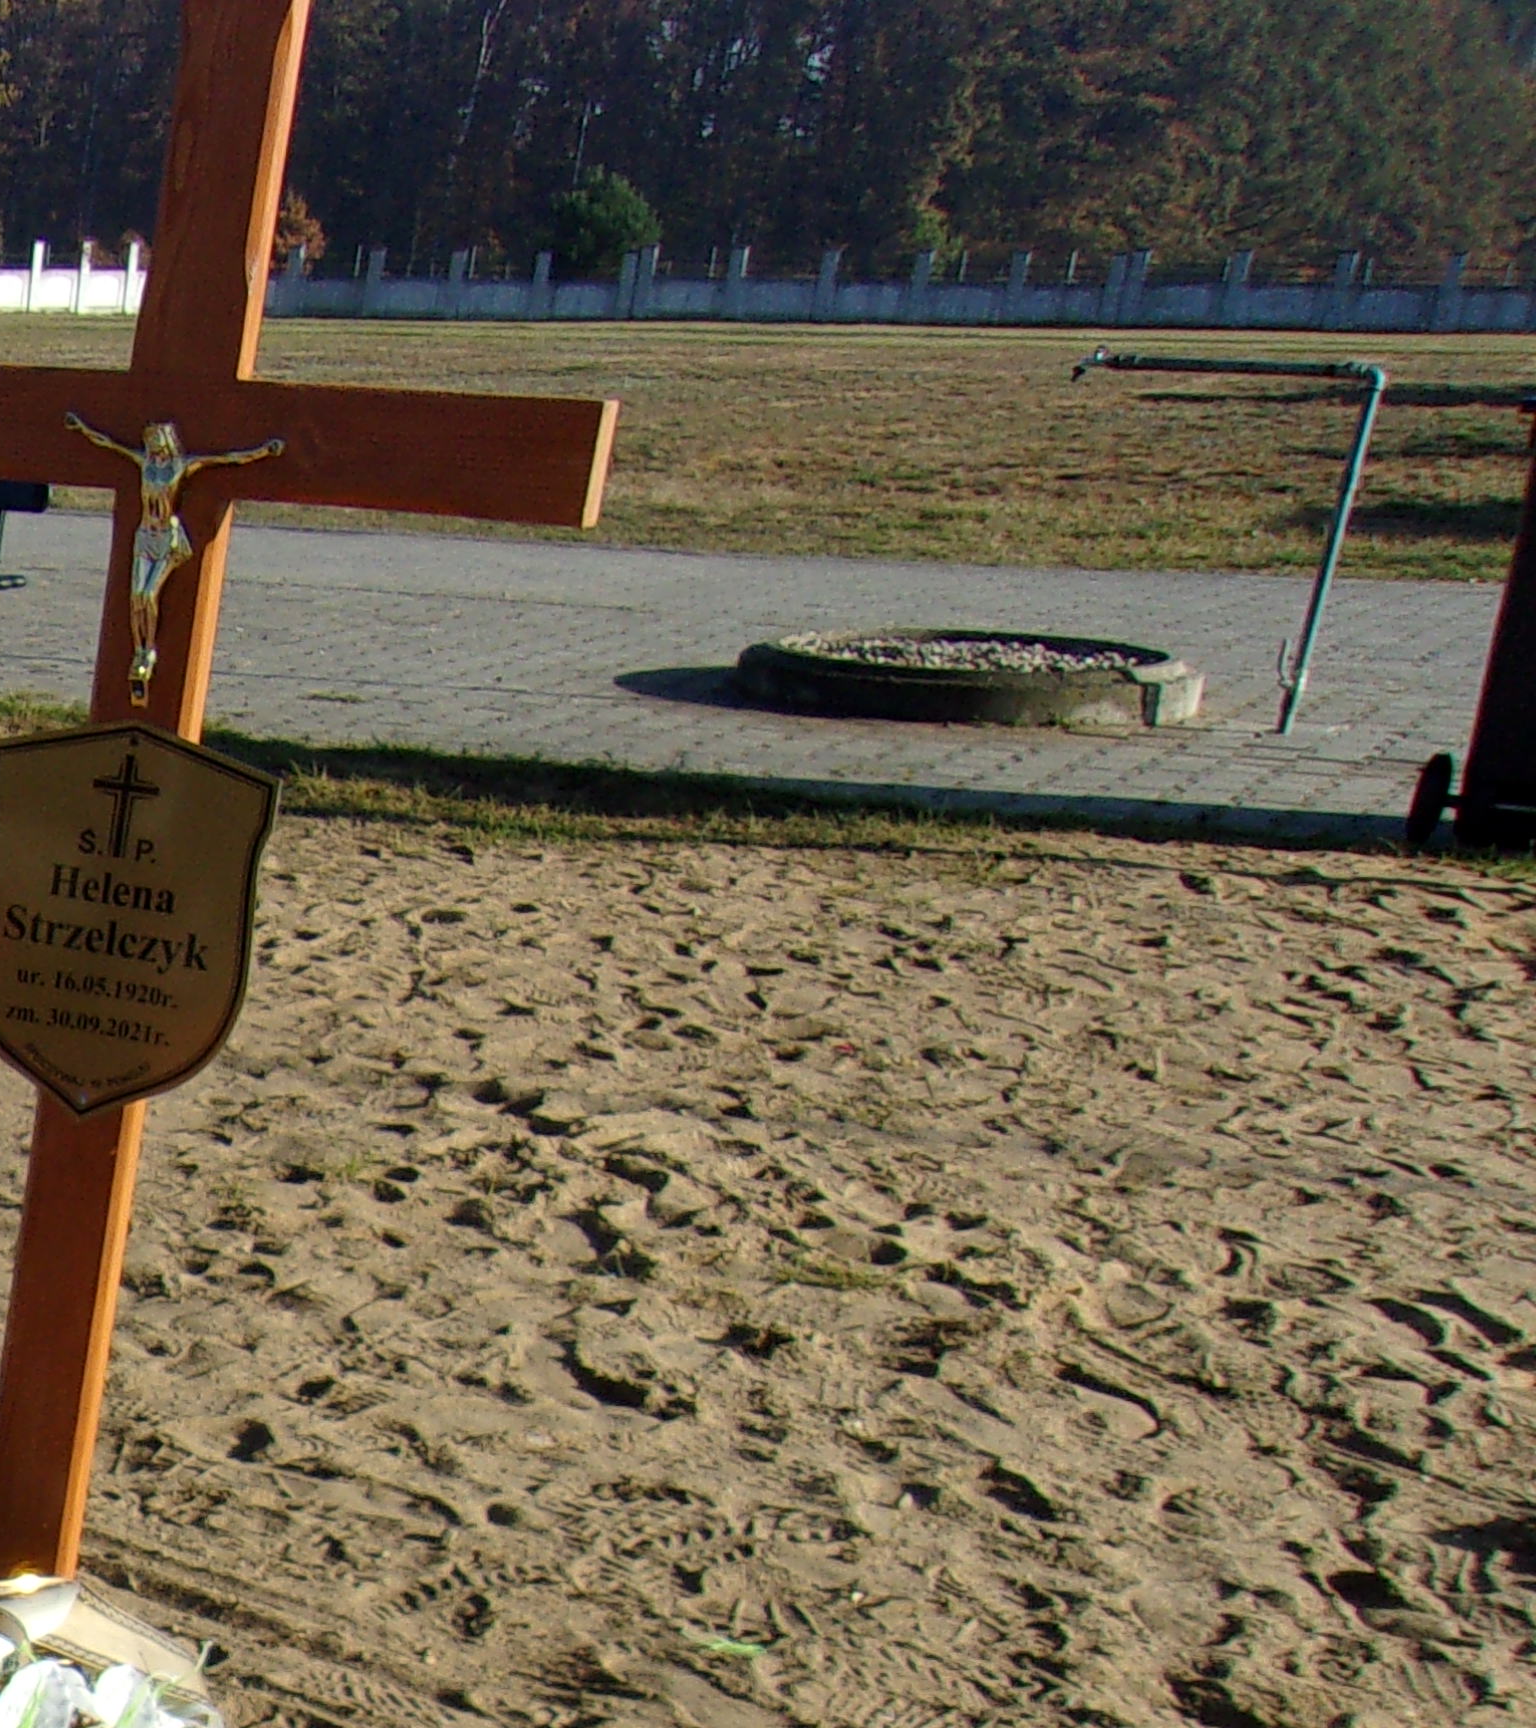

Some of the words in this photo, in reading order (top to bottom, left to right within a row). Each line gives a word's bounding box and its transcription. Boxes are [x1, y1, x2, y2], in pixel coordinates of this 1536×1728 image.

[135, 838, 157, 864] P.
[50, 863, 175, 914] Helena
[3, 903, 208, 975] Strzelczyk
[16, 968, 46, 987] ur.
[54, 970, 178, 1009] 16.05.1920r.
[5, 1005, 40, 1024] zm.
[46, 1008, 171, 1046] 30.09.2021r.
